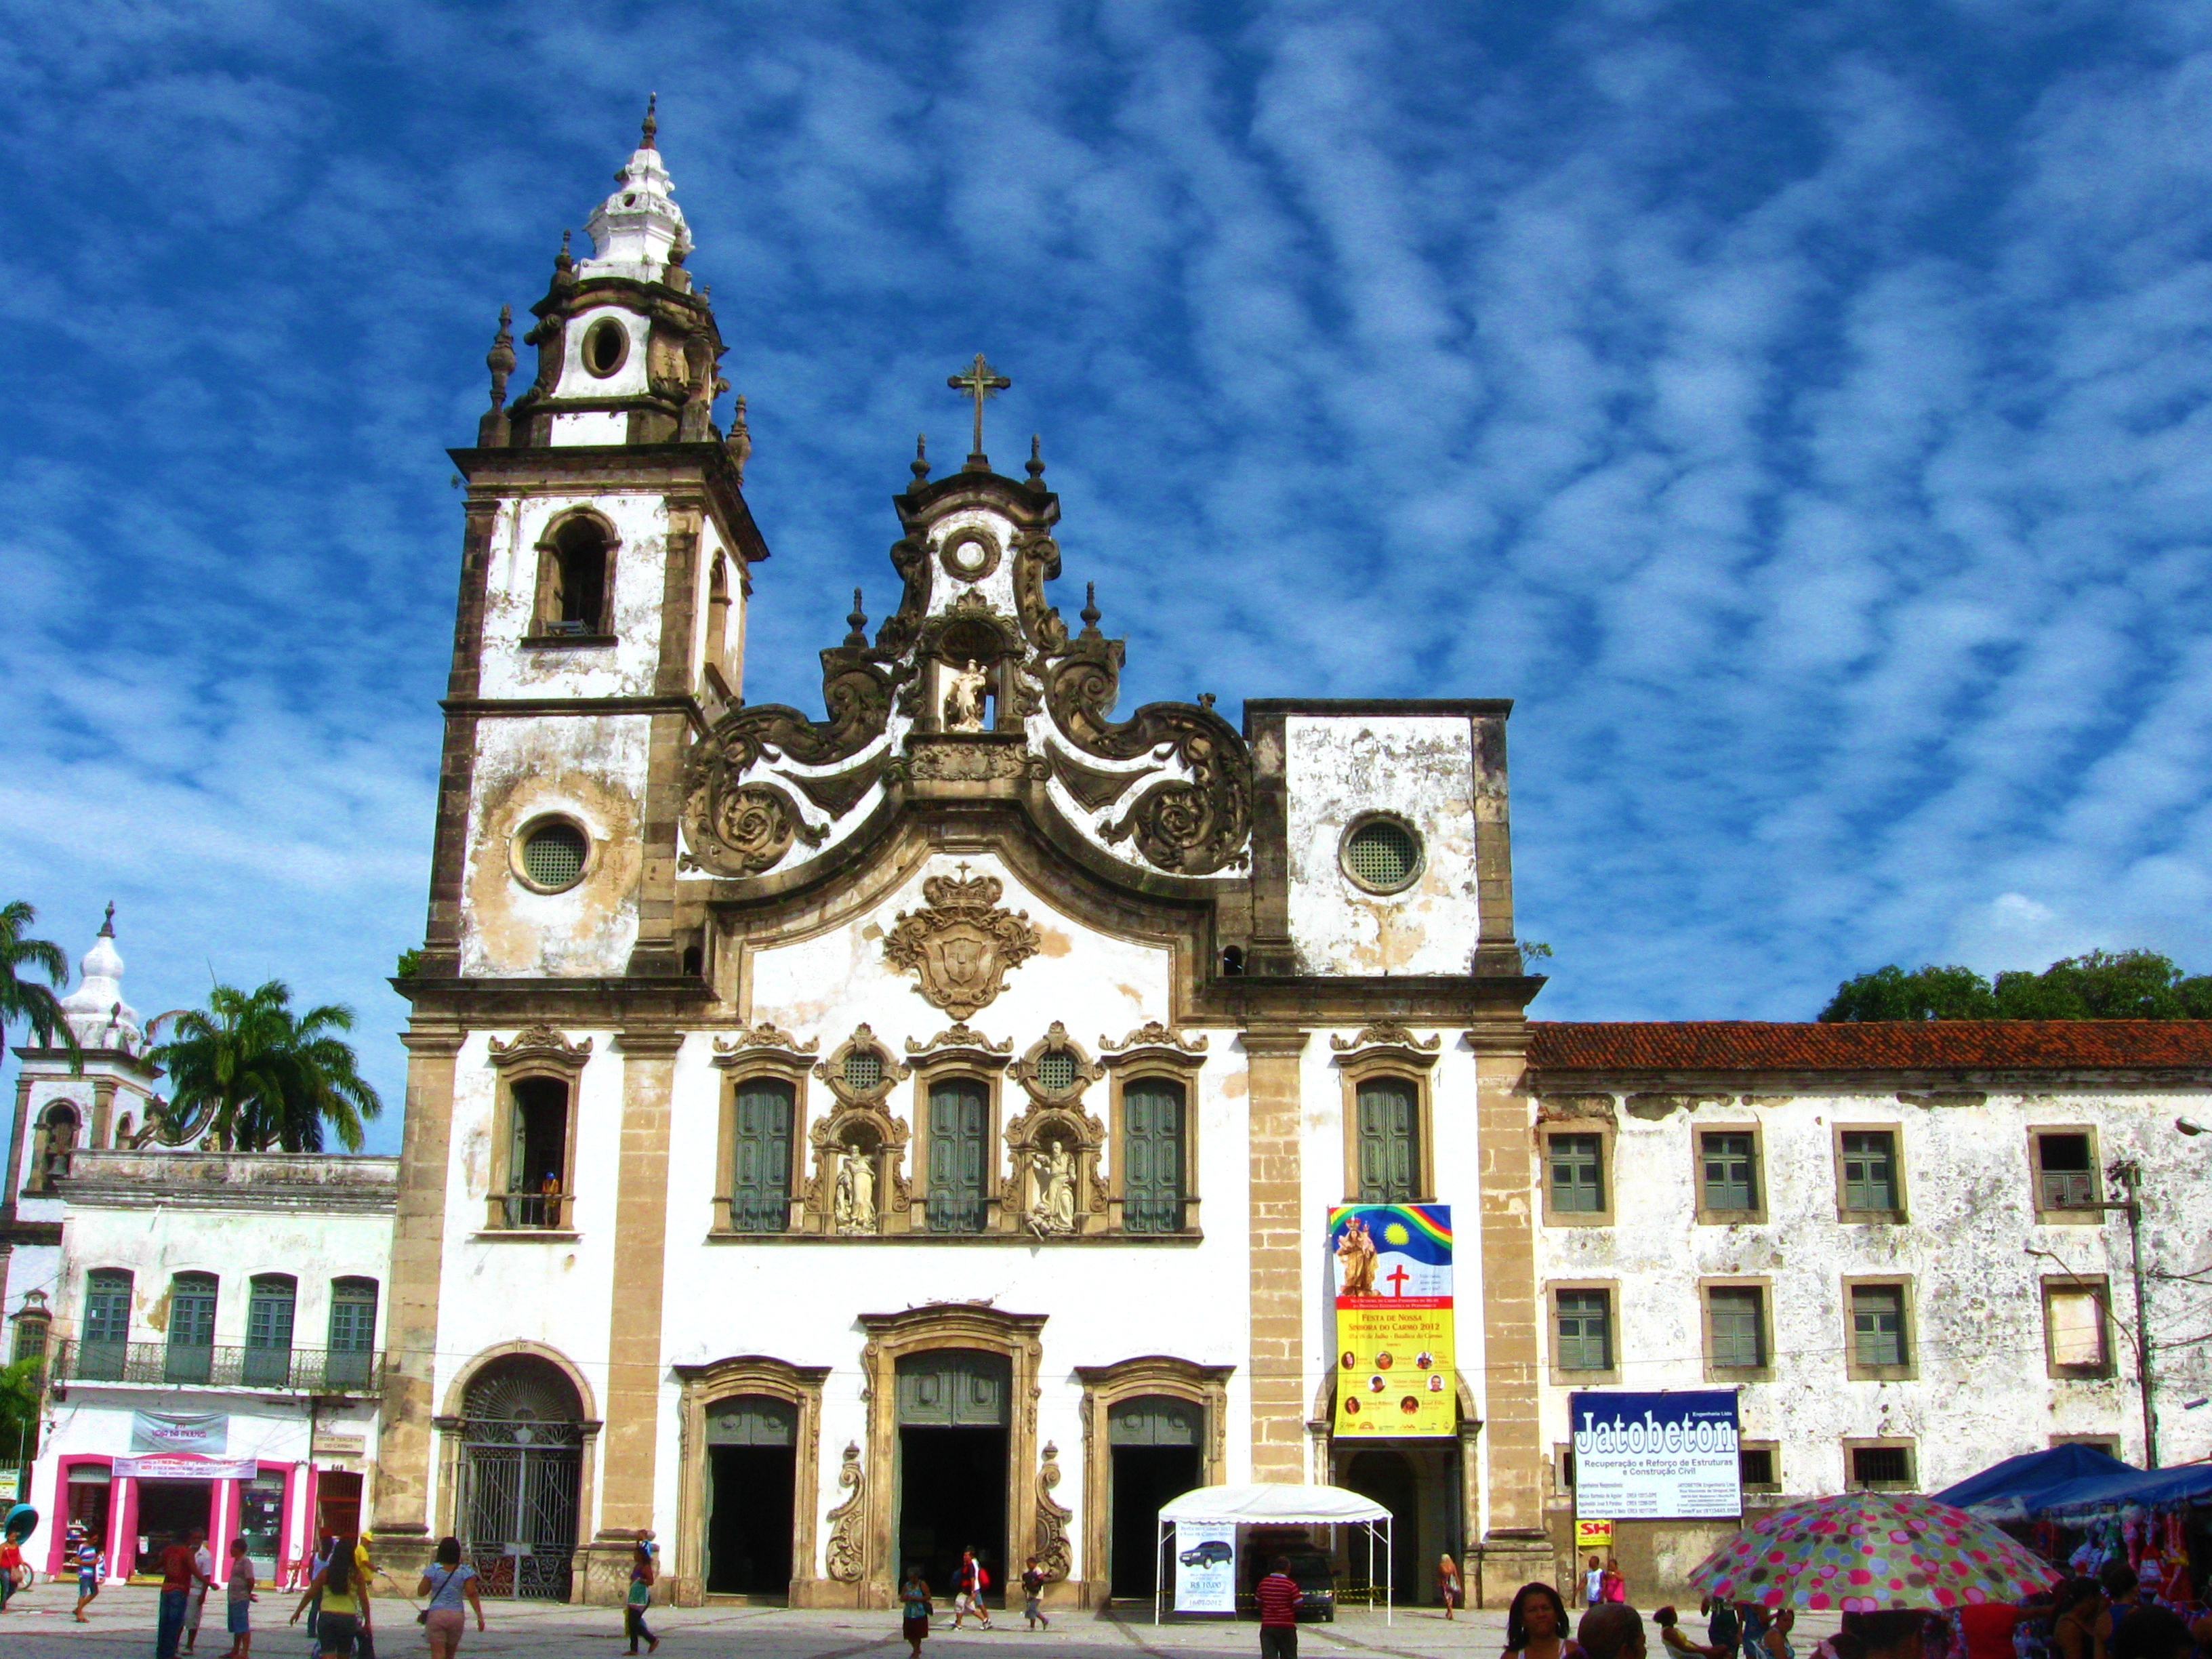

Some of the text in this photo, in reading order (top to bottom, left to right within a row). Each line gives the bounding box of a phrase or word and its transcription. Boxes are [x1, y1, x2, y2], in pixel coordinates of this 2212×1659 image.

[1398, 1313, 1422, 1322] NOSSA
[1575, 1410, 1736, 1454] Jatobeton
[1584, 1459, 1637, 1469] Recuperação
[1645, 1459, 1677, 1469] Reforço
[1692, 1458, 1733, 1466] Estruturas
[1629, 1468, 1676, 1477] Construção
[1580, 1523, 1610, 1535] SH
